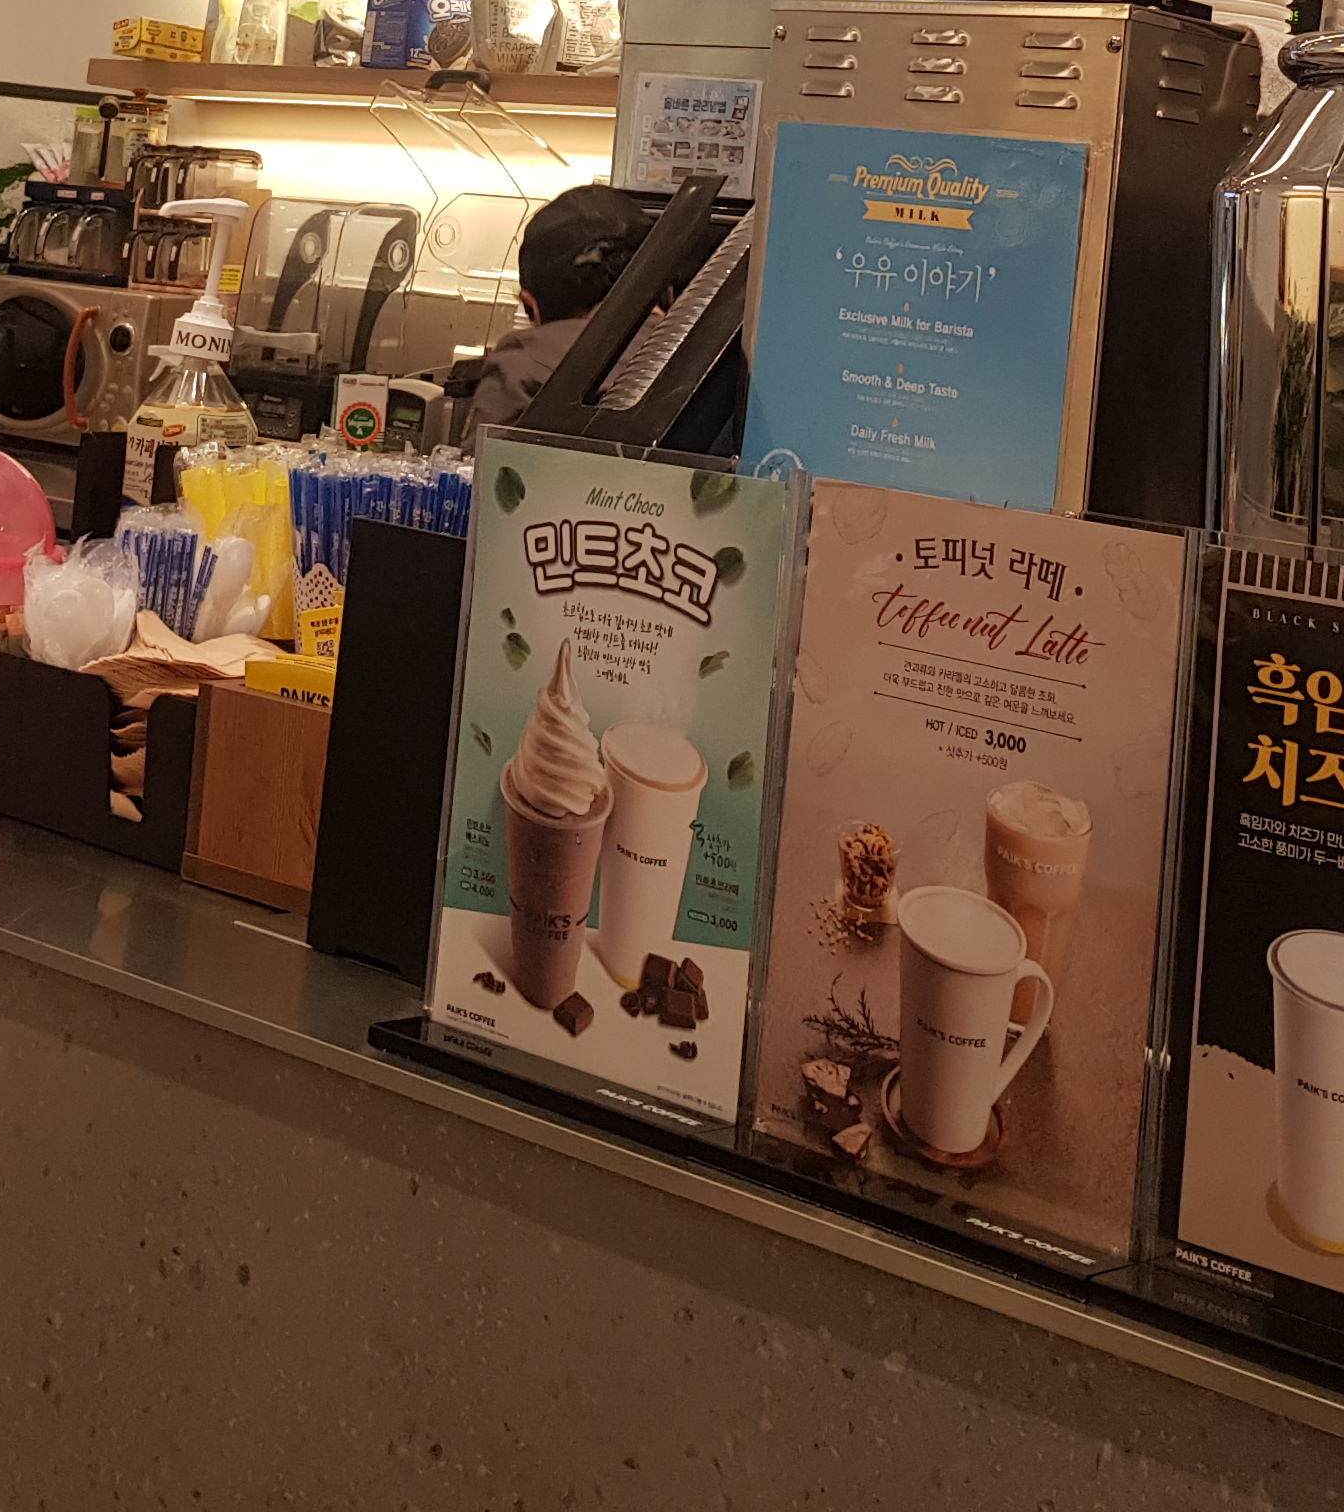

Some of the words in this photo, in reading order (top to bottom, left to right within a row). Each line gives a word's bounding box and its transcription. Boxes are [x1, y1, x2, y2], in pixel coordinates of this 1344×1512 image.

[853, 165, 923, 198] Premium
[926, 172, 990, 204] Quality
[894, 207, 940, 221] MILK
[839, 308, 887, 326] Exclusive
[891, 313, 912, 329] Milk
[916, 317, 930, 331] for
[934, 320, 973, 337] Barista
[841, 370, 882, 387] Smooth
[896, 377, 925, 394] Deep
[930, 382, 958, 399] Taste
[850, 424, 877, 442] Daily
[880, 429, 910, 446] Fresh
[915, 434, 935, 450] Milk
[586, 487, 623, 509] Mint
[624, 493, 664, 517] Choco
[524, 519, 718, 627] 민트초코
[914, 538, 995, 580] 토피넛
[1010, 549, 1067, 602] 라떼
[1253, 608, 1317, 629] BLACK
[1015, 616, 1105, 665] Latte
[926, 719, 945, 731] HOT
[956, 724, 978, 739] ICED
[985, 730, 1026, 753] 3,000
[1238, 833, 1273, 854] 고소한
[1239, 813, 1286, 838] 흑임자와
[1289, 824, 1324, 845] 치즈가
[948, 1034, 986, 1048] COFFEE
[1298, 1078, 1328, 1099] PAIK'S
[1175, 1248, 1208, 1268] PAIK'S
[1210, 1259, 1252, 1283] COFFEE
